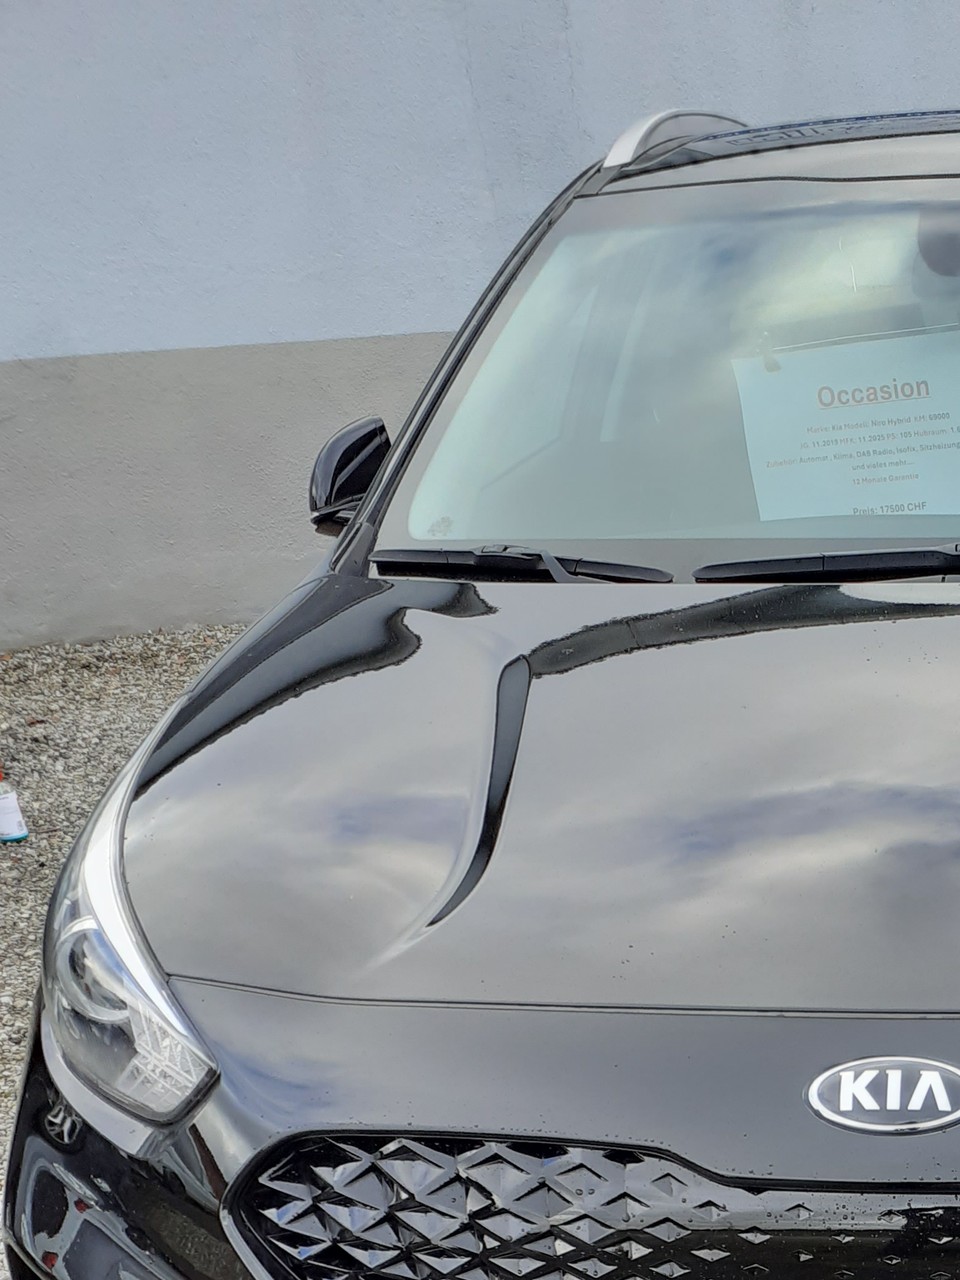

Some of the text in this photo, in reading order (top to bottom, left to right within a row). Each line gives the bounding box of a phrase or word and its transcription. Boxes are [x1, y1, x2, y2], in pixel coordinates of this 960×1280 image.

[817, 378, 931, 409] Occasion
[887, 416, 912, 427] Hybrid
[856, 449, 872, 458] DAB
[852, 501, 928, 515] Preis: 17500 CHF
[839, 1069, 952, 1112] KIA
